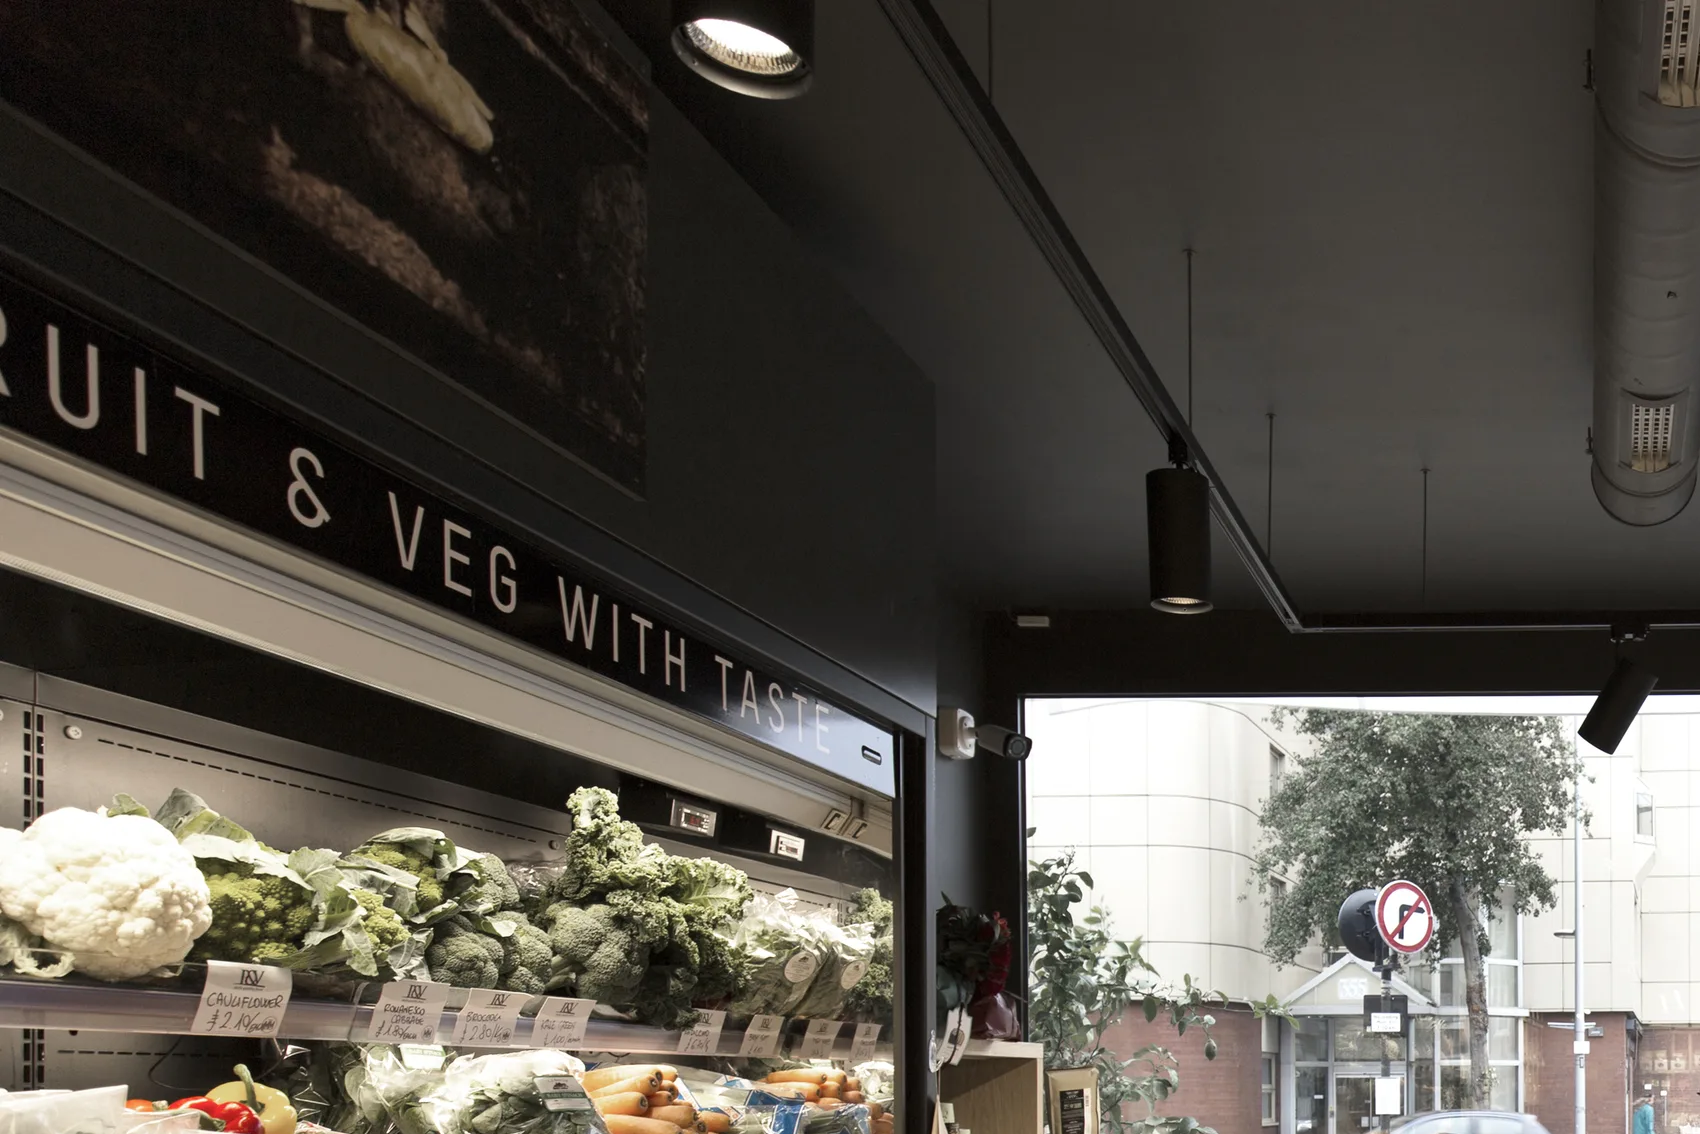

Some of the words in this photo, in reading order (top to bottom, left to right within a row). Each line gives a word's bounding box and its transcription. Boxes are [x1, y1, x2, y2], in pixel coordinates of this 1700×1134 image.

[0, 303, 220, 481] UIT
[287, 447, 332, 528] &
[388, 490, 517, 614] VEG
[557, 575, 687, 693] WITH
[714, 654, 830, 756] TASTE
[207, 991, 283, 1009] CAULIFLOWER
